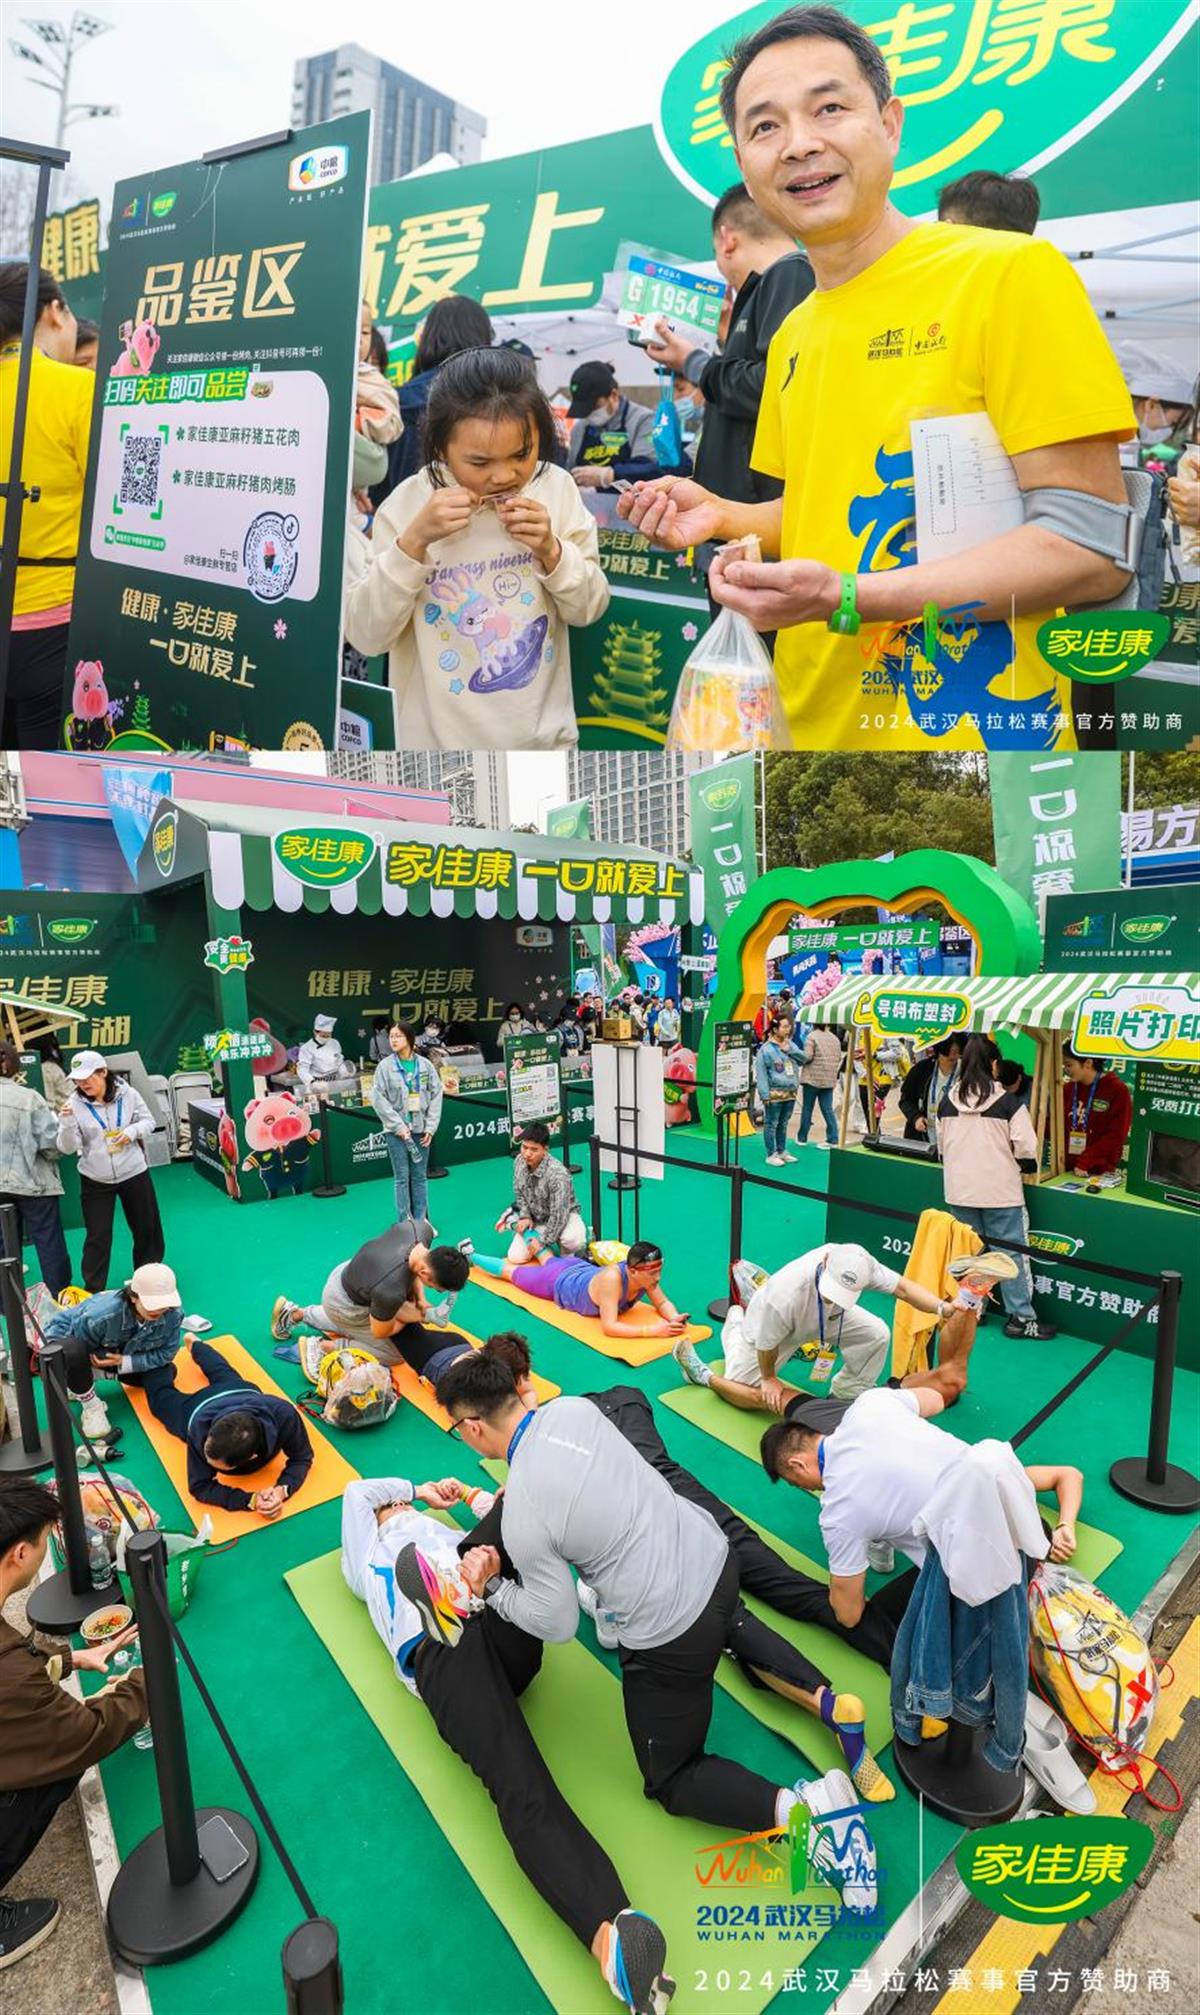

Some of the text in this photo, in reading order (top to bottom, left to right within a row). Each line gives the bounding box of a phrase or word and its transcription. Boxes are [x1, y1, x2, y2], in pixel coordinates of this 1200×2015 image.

[134, 241, 305, 327] 品鉴区
[627, 274, 700, 320] G 1954
[103, 371, 249, 404] 扫码关注即可品尝
[187, 425, 300, 448] 家佳康亚麻籽猪五花肉
[183, 469, 296, 497] 家佳康亚麻籽猪肉烤肠
[149, 637, 257, 689] 一口就爱上
[281, 835, 685, 898] 家佳康 家佳康 一口就爱上
[791, 932, 839, 949] 家佳康
[843, 928, 933, 946] 一口就爱上
[361, 997, 505, 1025] 一口就爱上
[877, 997, 958, 1025] 号码布塑封
